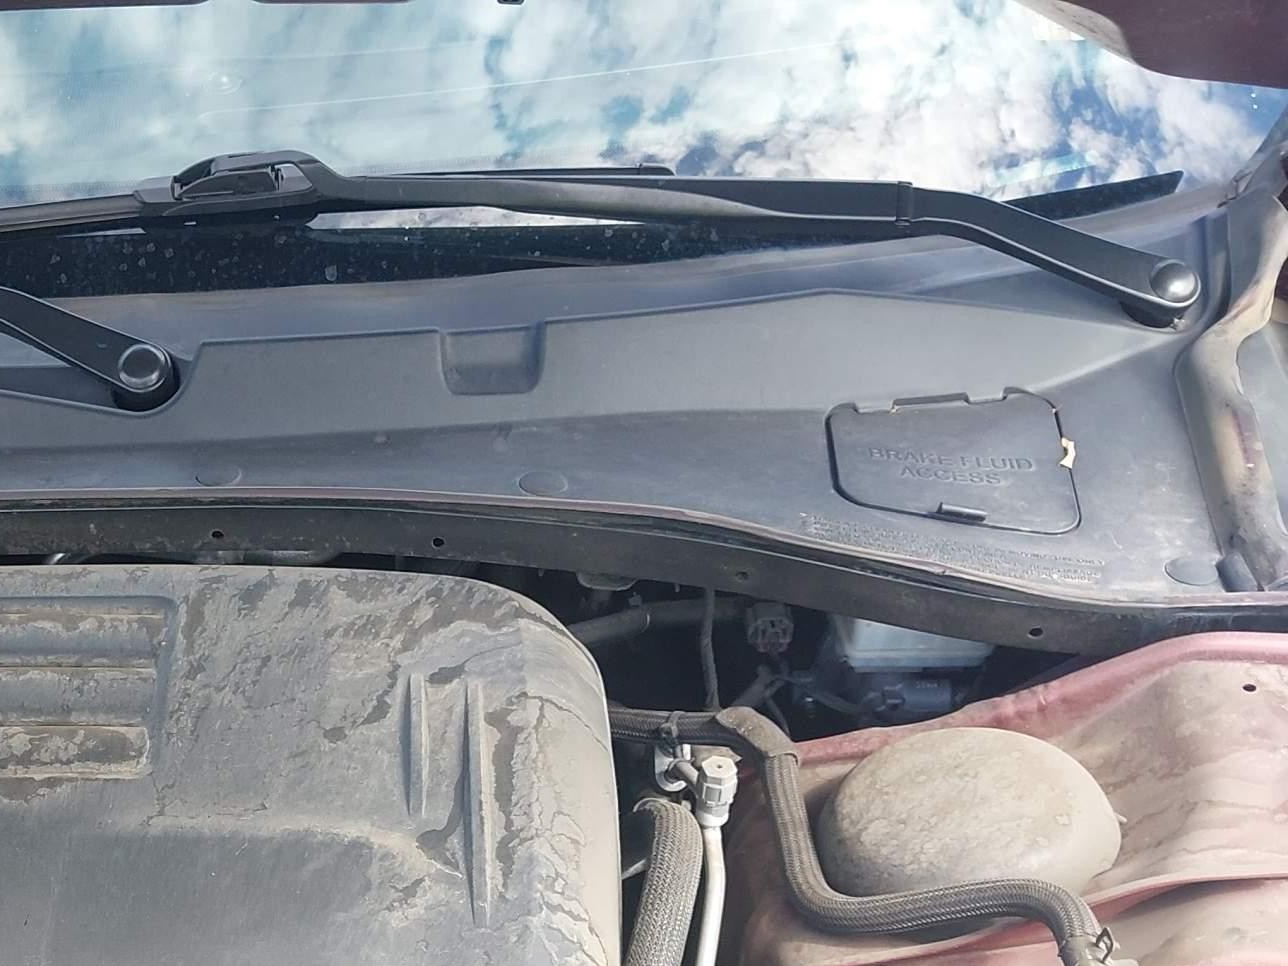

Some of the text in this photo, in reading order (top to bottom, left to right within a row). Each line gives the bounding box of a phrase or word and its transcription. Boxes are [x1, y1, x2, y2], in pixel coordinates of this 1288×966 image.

[868, 447, 1034, 471] BRAKE FLUID
[901, 465, 1002, 485] ACCESS
